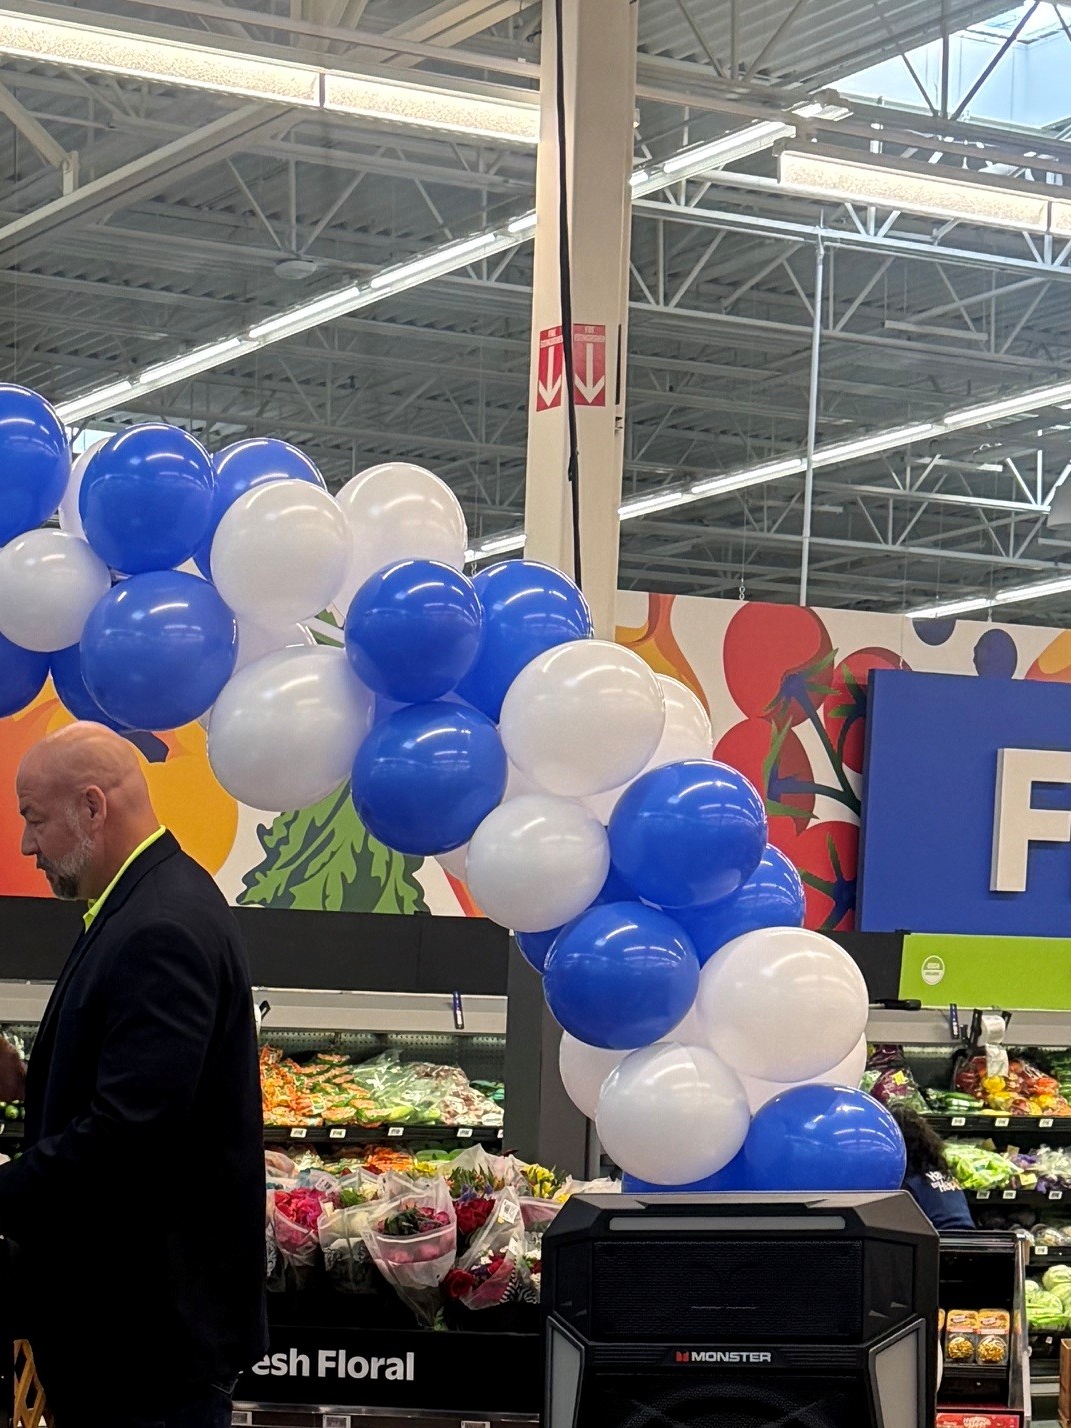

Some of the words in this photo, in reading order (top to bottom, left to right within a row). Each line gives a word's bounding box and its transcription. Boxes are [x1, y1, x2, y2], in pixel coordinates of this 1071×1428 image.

[251, 1347, 311, 1376] esh
[317, 1349, 415, 1381] Floral
[691, 1351, 772, 1363] MONSTER
